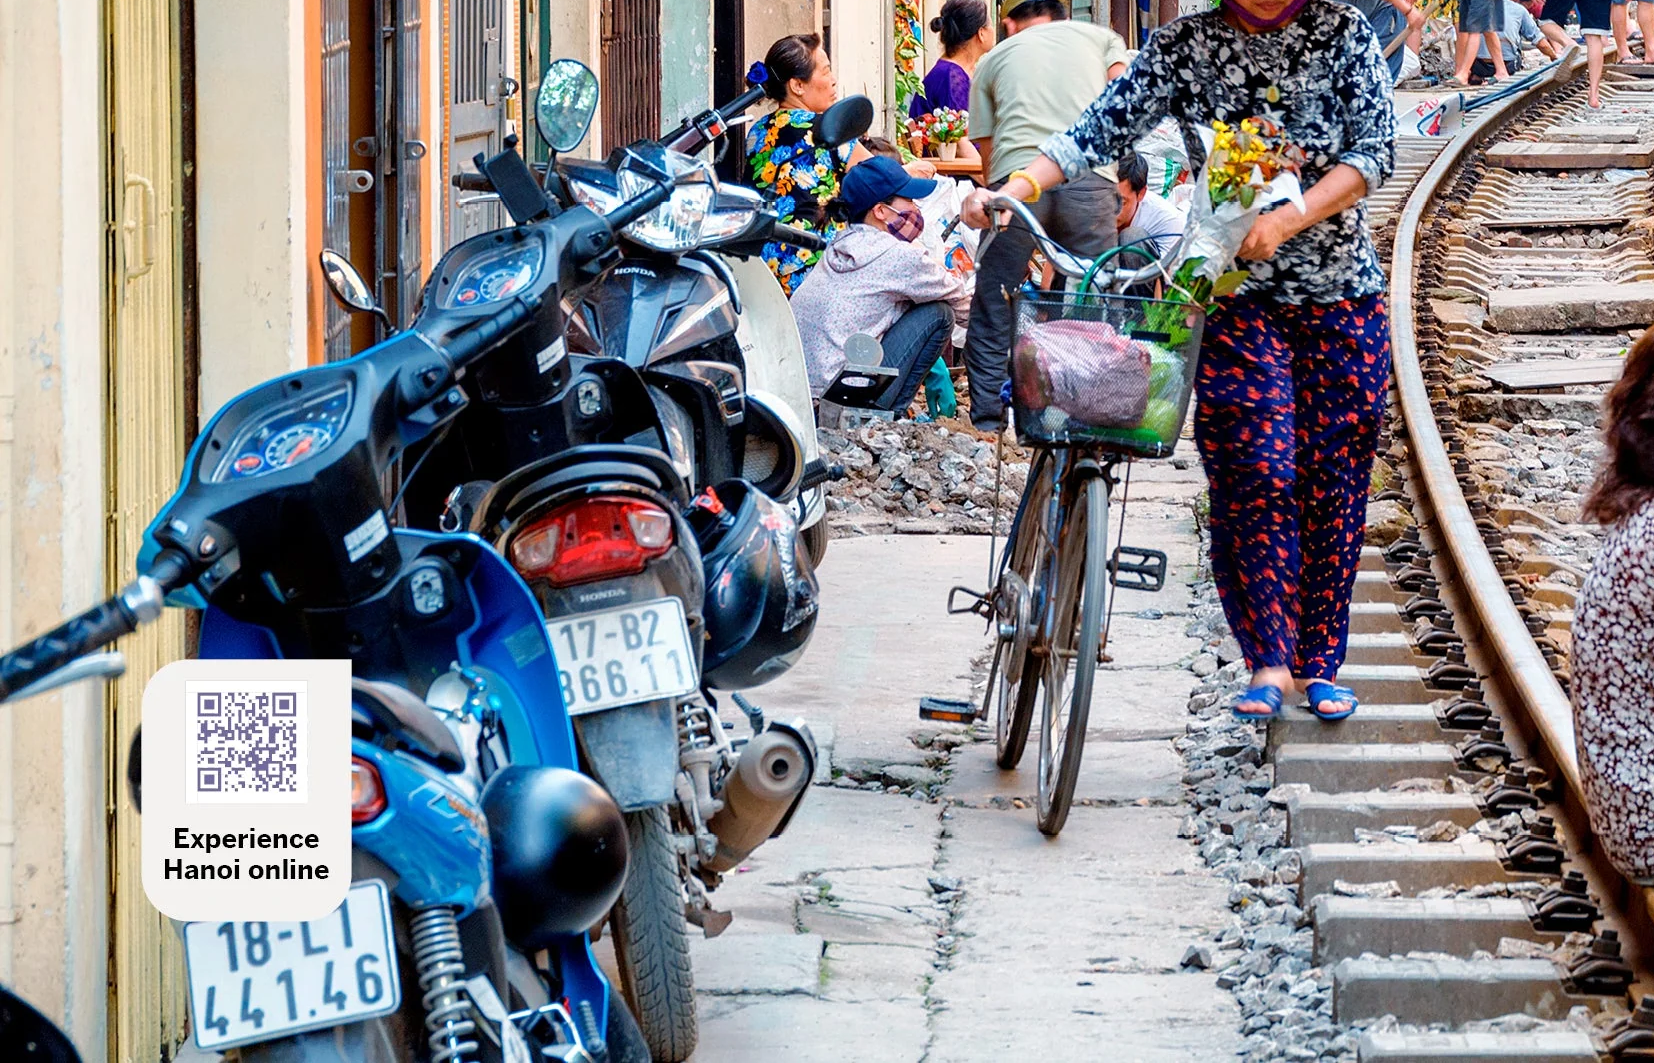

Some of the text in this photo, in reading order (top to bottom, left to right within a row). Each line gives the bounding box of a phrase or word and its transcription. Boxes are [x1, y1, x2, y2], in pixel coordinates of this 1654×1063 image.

[614, 266, 657, 278] HONDA
[579, 588, 626, 603] HONDA
[560, 609, 666, 661] 17-B2
[217, 898, 353, 972] 18-L1
[205, 953, 384, 1036] 441.46
